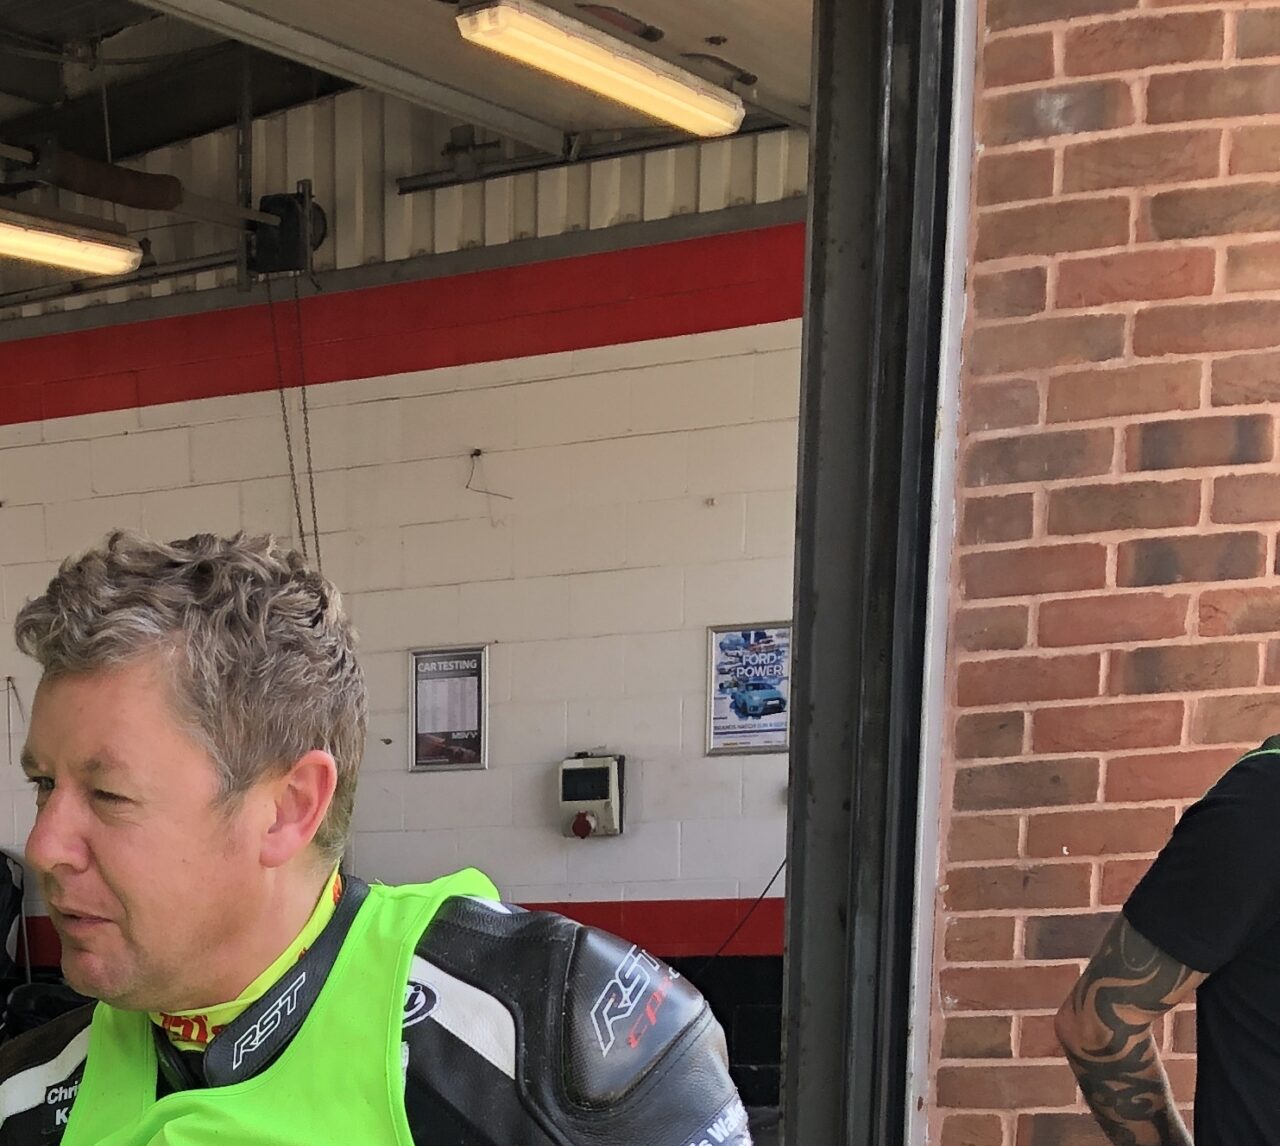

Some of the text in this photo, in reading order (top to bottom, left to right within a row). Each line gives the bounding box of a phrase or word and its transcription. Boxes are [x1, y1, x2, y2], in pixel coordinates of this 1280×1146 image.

[417, 659, 478, 673] CAR TESTING
[742, 653, 777, 666] FORD
[736, 665, 784, 678] POWER
[231, 971, 306, 1071] RST
[46, 1080, 81, 1106] Chri
